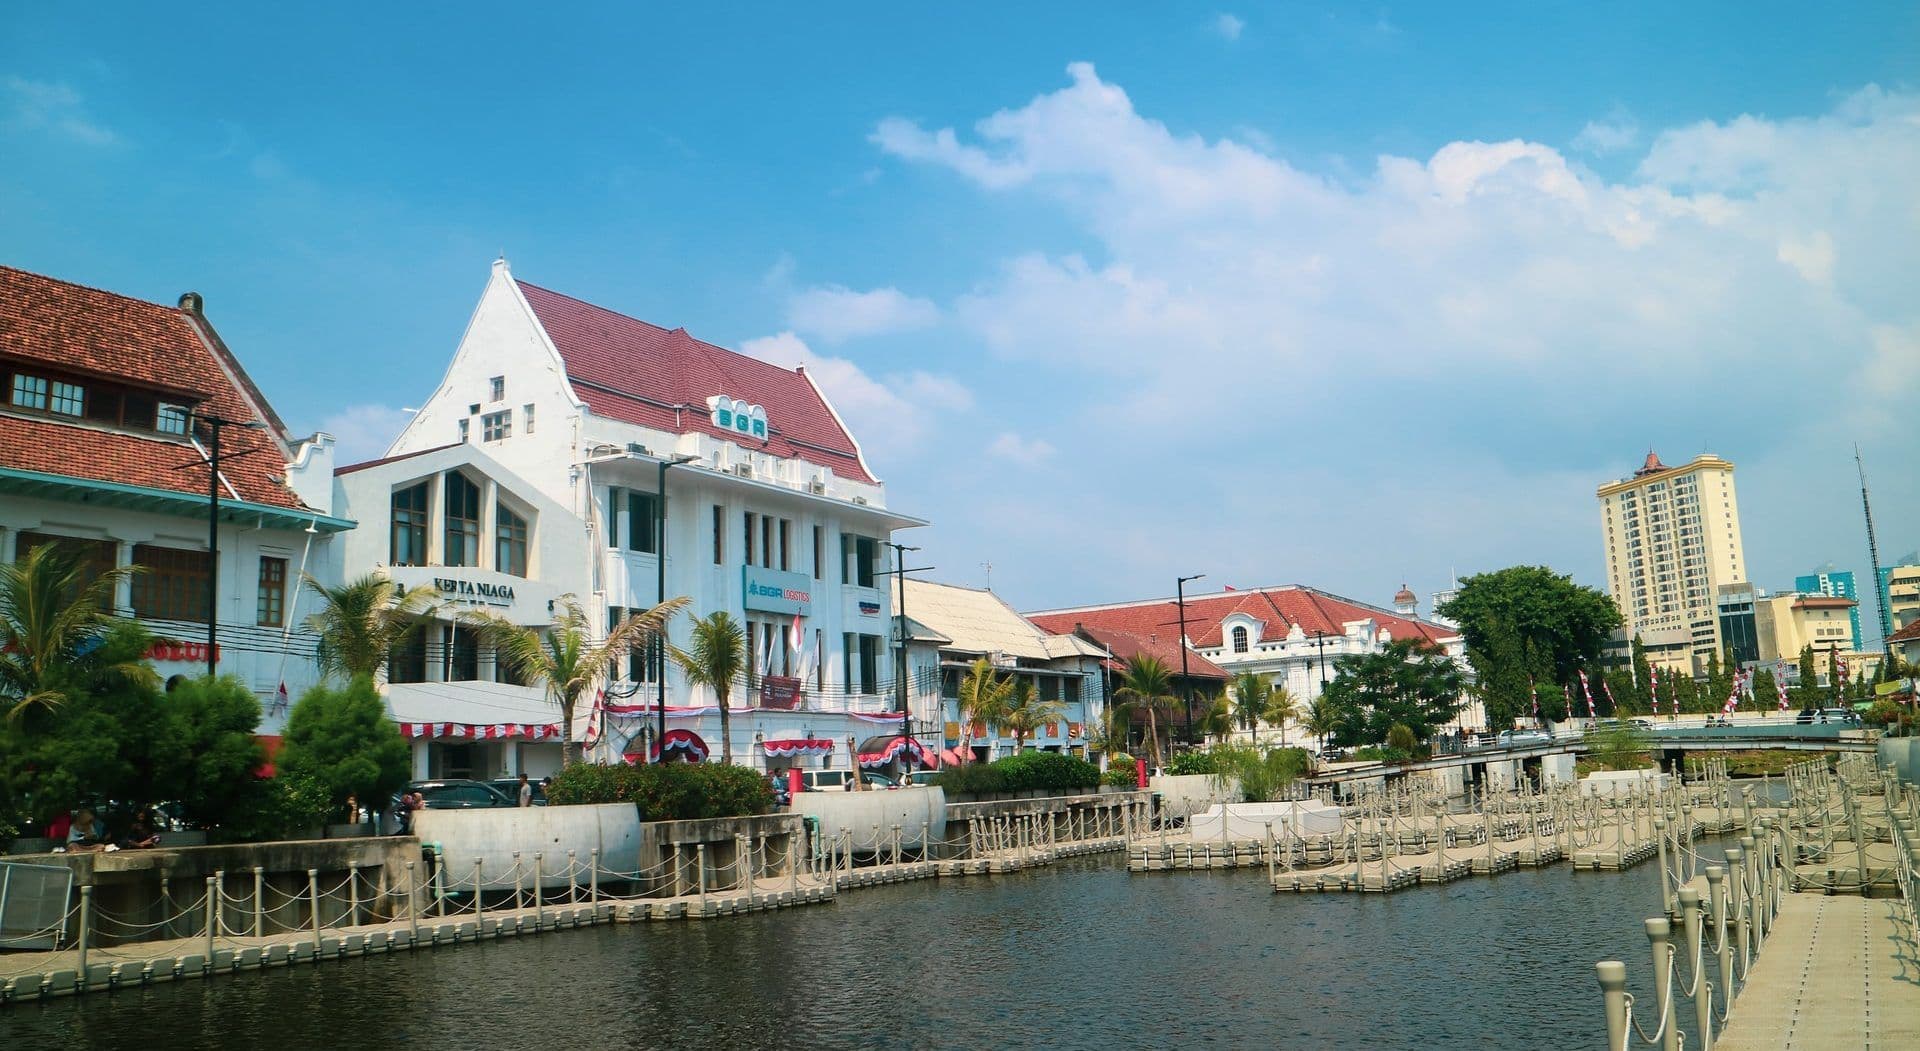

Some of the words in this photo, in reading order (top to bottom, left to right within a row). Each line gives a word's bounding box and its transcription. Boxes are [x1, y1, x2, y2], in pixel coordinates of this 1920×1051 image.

[719, 409, 765, 437] BGR
[434, 578, 475, 595] KERTA
[477, 582, 515, 600] NIAGA
[759, 585, 783, 598] BGR
